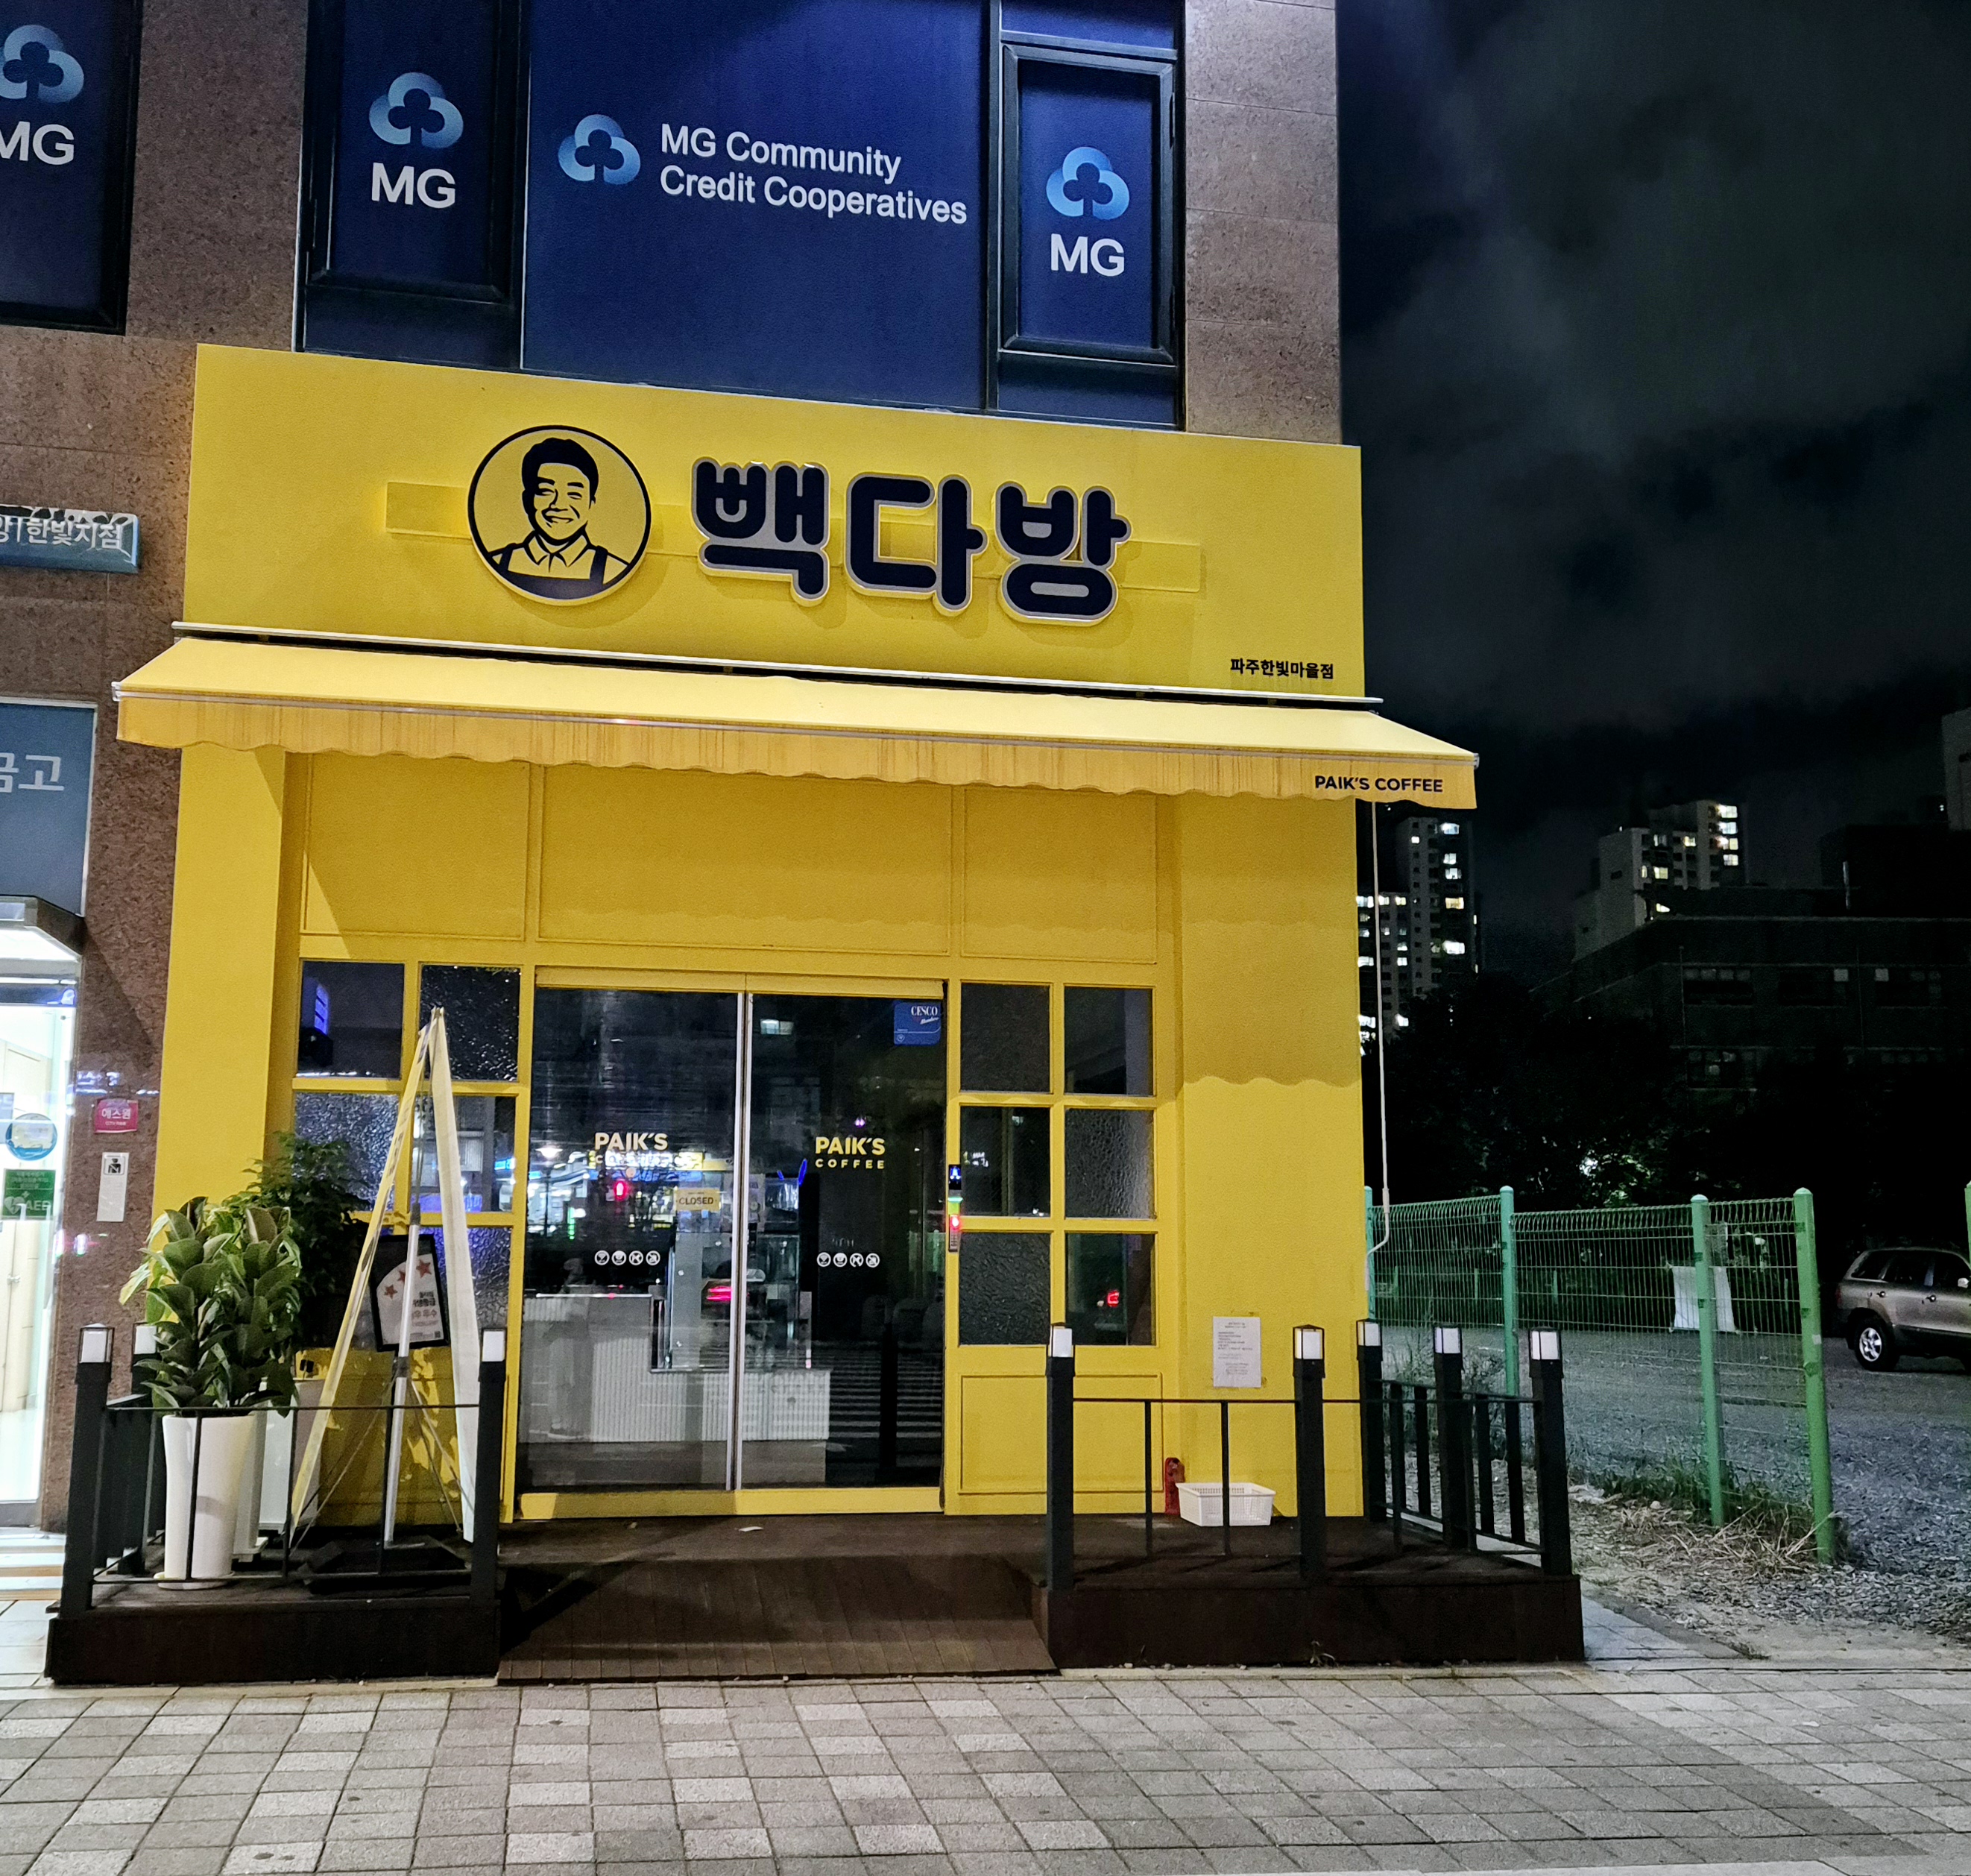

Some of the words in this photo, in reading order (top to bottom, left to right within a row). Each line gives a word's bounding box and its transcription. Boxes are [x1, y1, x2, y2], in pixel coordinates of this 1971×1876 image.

[662, 123, 716, 157] MG
[725, 131, 901, 183] Community
[371, 162, 455, 209] MG
[660, 165, 755, 203] Credit
[764, 175, 967, 224] Cooperatives
[1050, 233, 1125, 277] MG
[693, 457, 1130, 623] 빽다방
[1230, 658, 1334, 680] 파주한빛마을점
[1315, 775, 1370, 790] PAIK'S
[1375, 778, 1443, 793] COFFEE
[910, 1006, 938, 1016] CESCO
[595, 1132, 668, 1151] PAIK'S
[815, 1136, 886, 1155] PAIK'S
[815, 1159, 885, 1169] COFFEE
[678, 1197, 713, 1205] CLOSED
